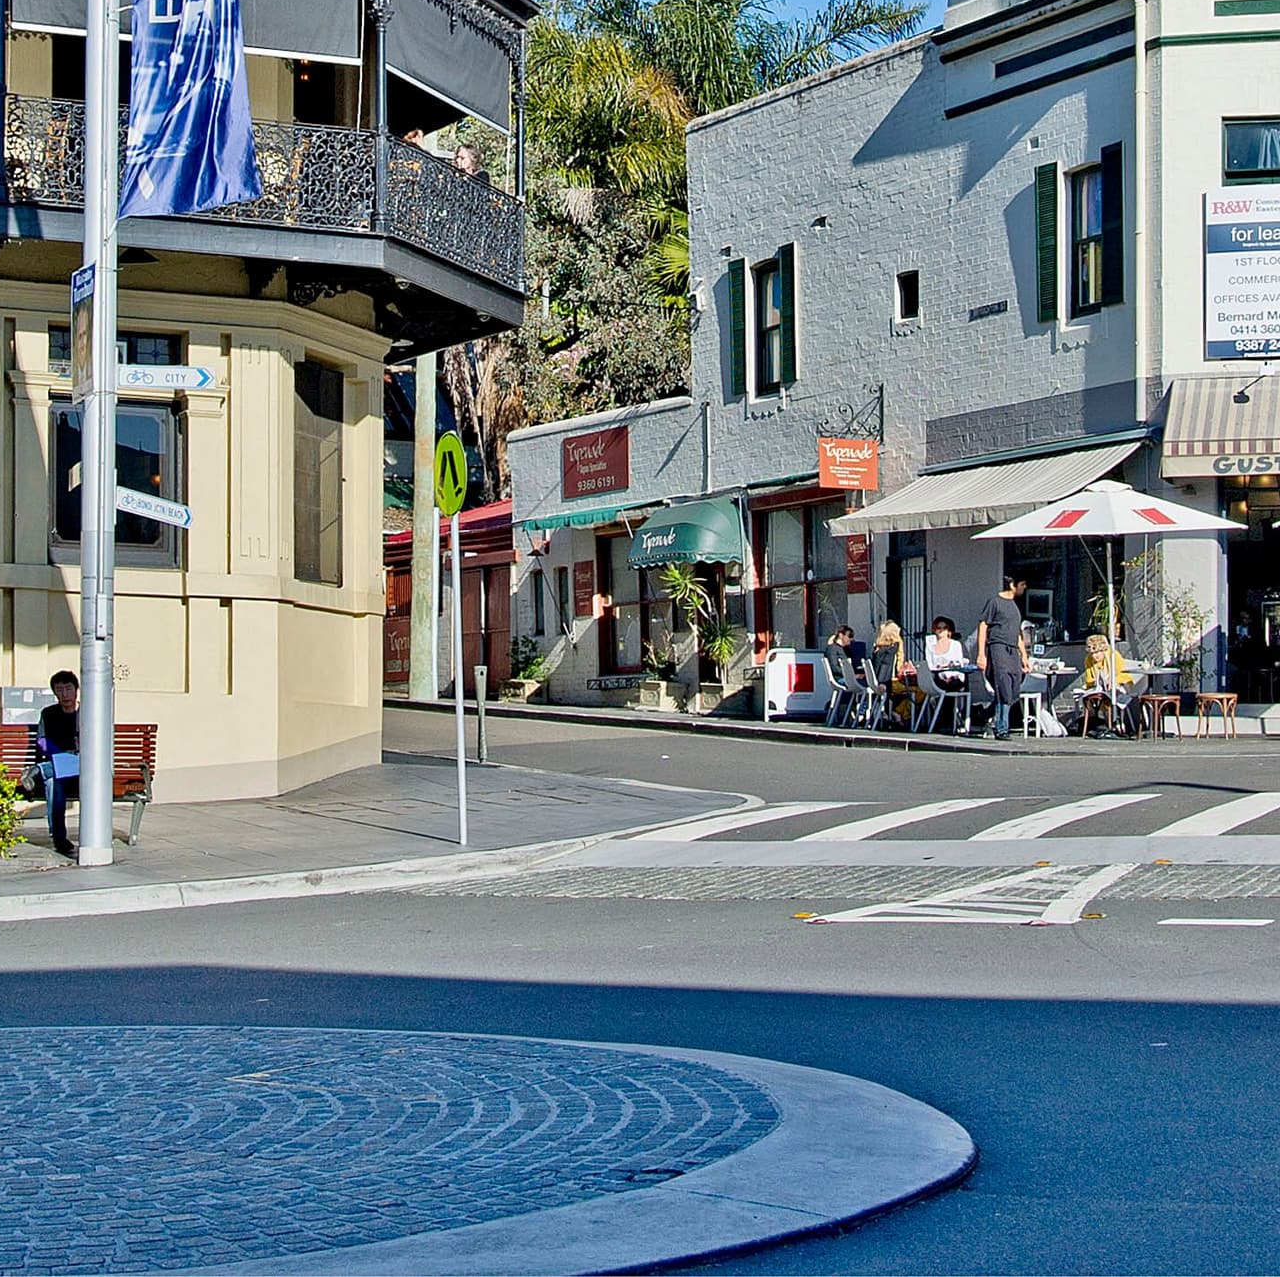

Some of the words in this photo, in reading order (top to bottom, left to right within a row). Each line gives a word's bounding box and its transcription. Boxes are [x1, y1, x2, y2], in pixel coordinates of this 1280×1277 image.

[1211, 200, 1253, 215] R&W
[1231, 226, 1254, 242] for
[1235, 258, 1253, 266] 1ST
[1213, 293, 1260, 304] OFFICES
[1217, 311, 1264, 322] Bernard
[1230, 325, 1257, 335] 0414
[1261, 324, 1280, 334] 360
[1235, 340, 1266, 351] 9387
[165, 374, 188, 383] CITY
[822, 443, 873, 465] Tapenade
[577, 481, 596, 491] 9360
[597, 476, 615, 487] 6191
